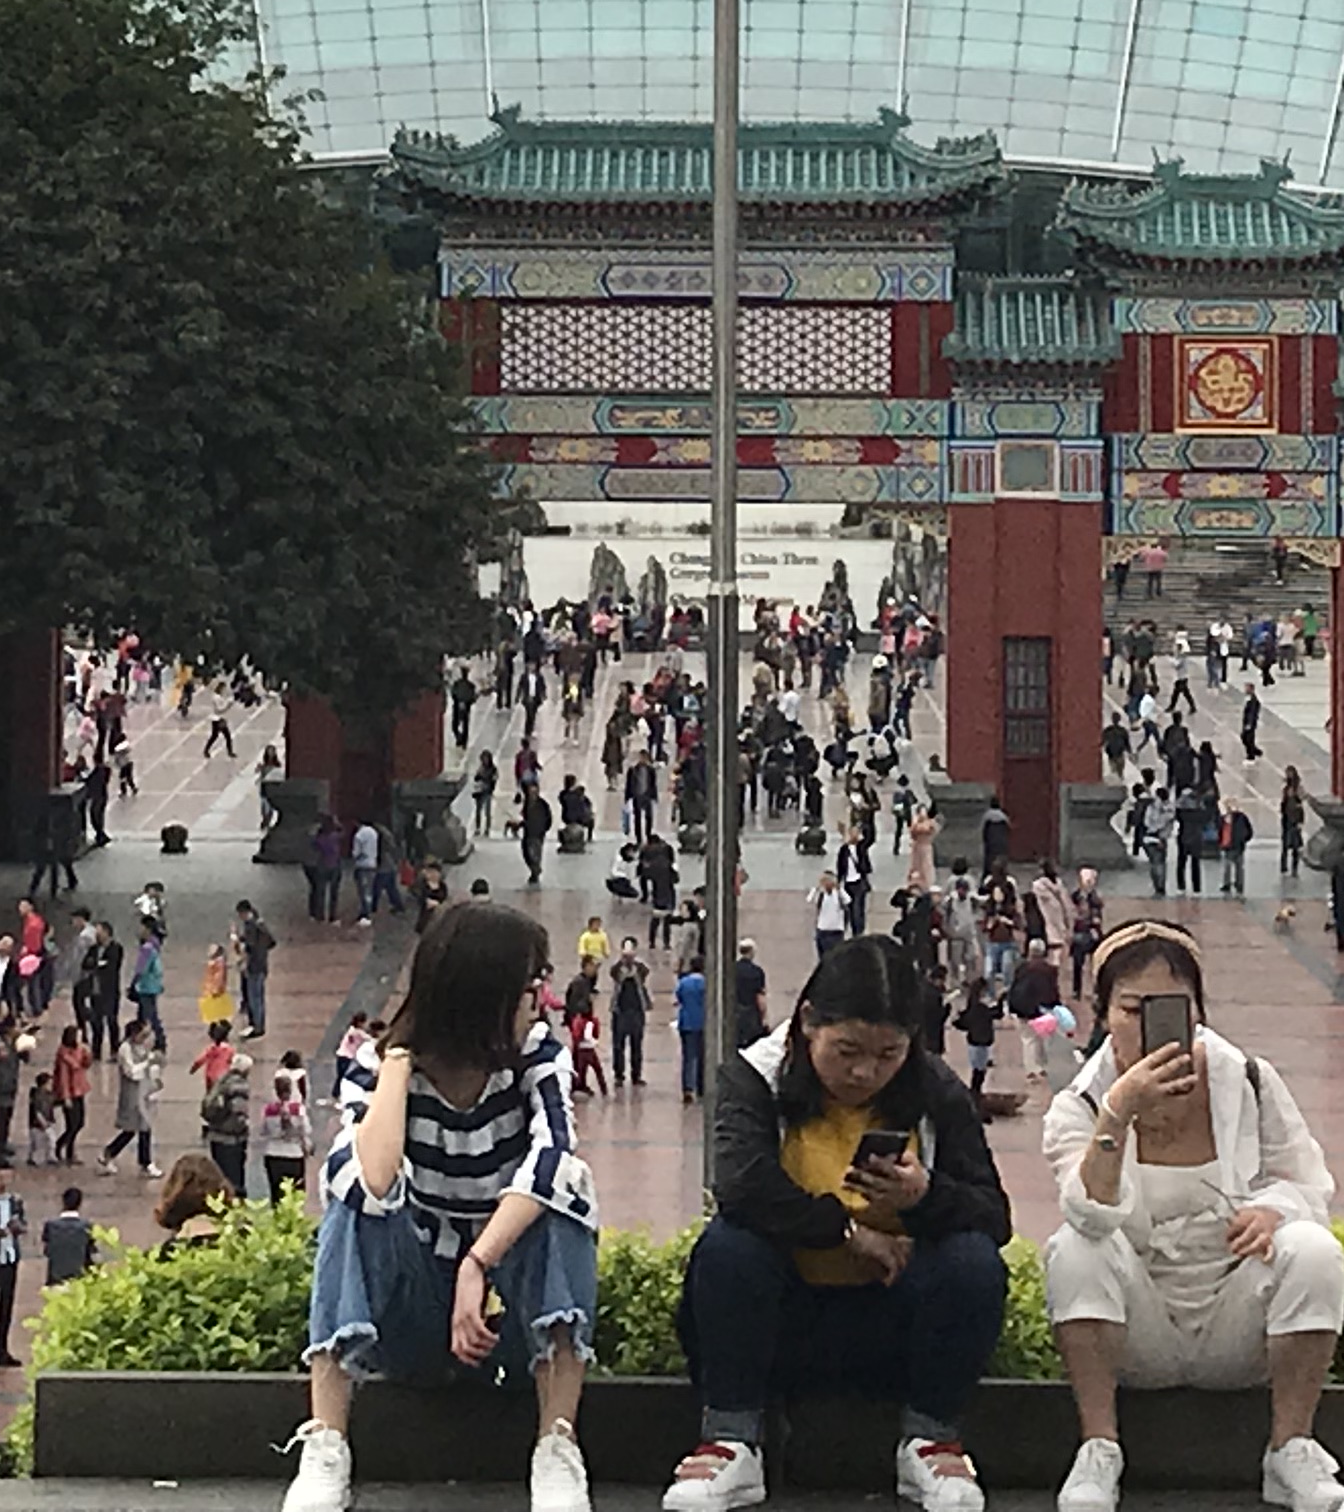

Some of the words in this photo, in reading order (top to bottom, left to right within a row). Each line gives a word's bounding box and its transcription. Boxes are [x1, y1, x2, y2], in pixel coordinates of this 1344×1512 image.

[669, 552, 711, 566] Chong
[741, 552, 777, 565] China
[782, 552, 818, 565] Three
